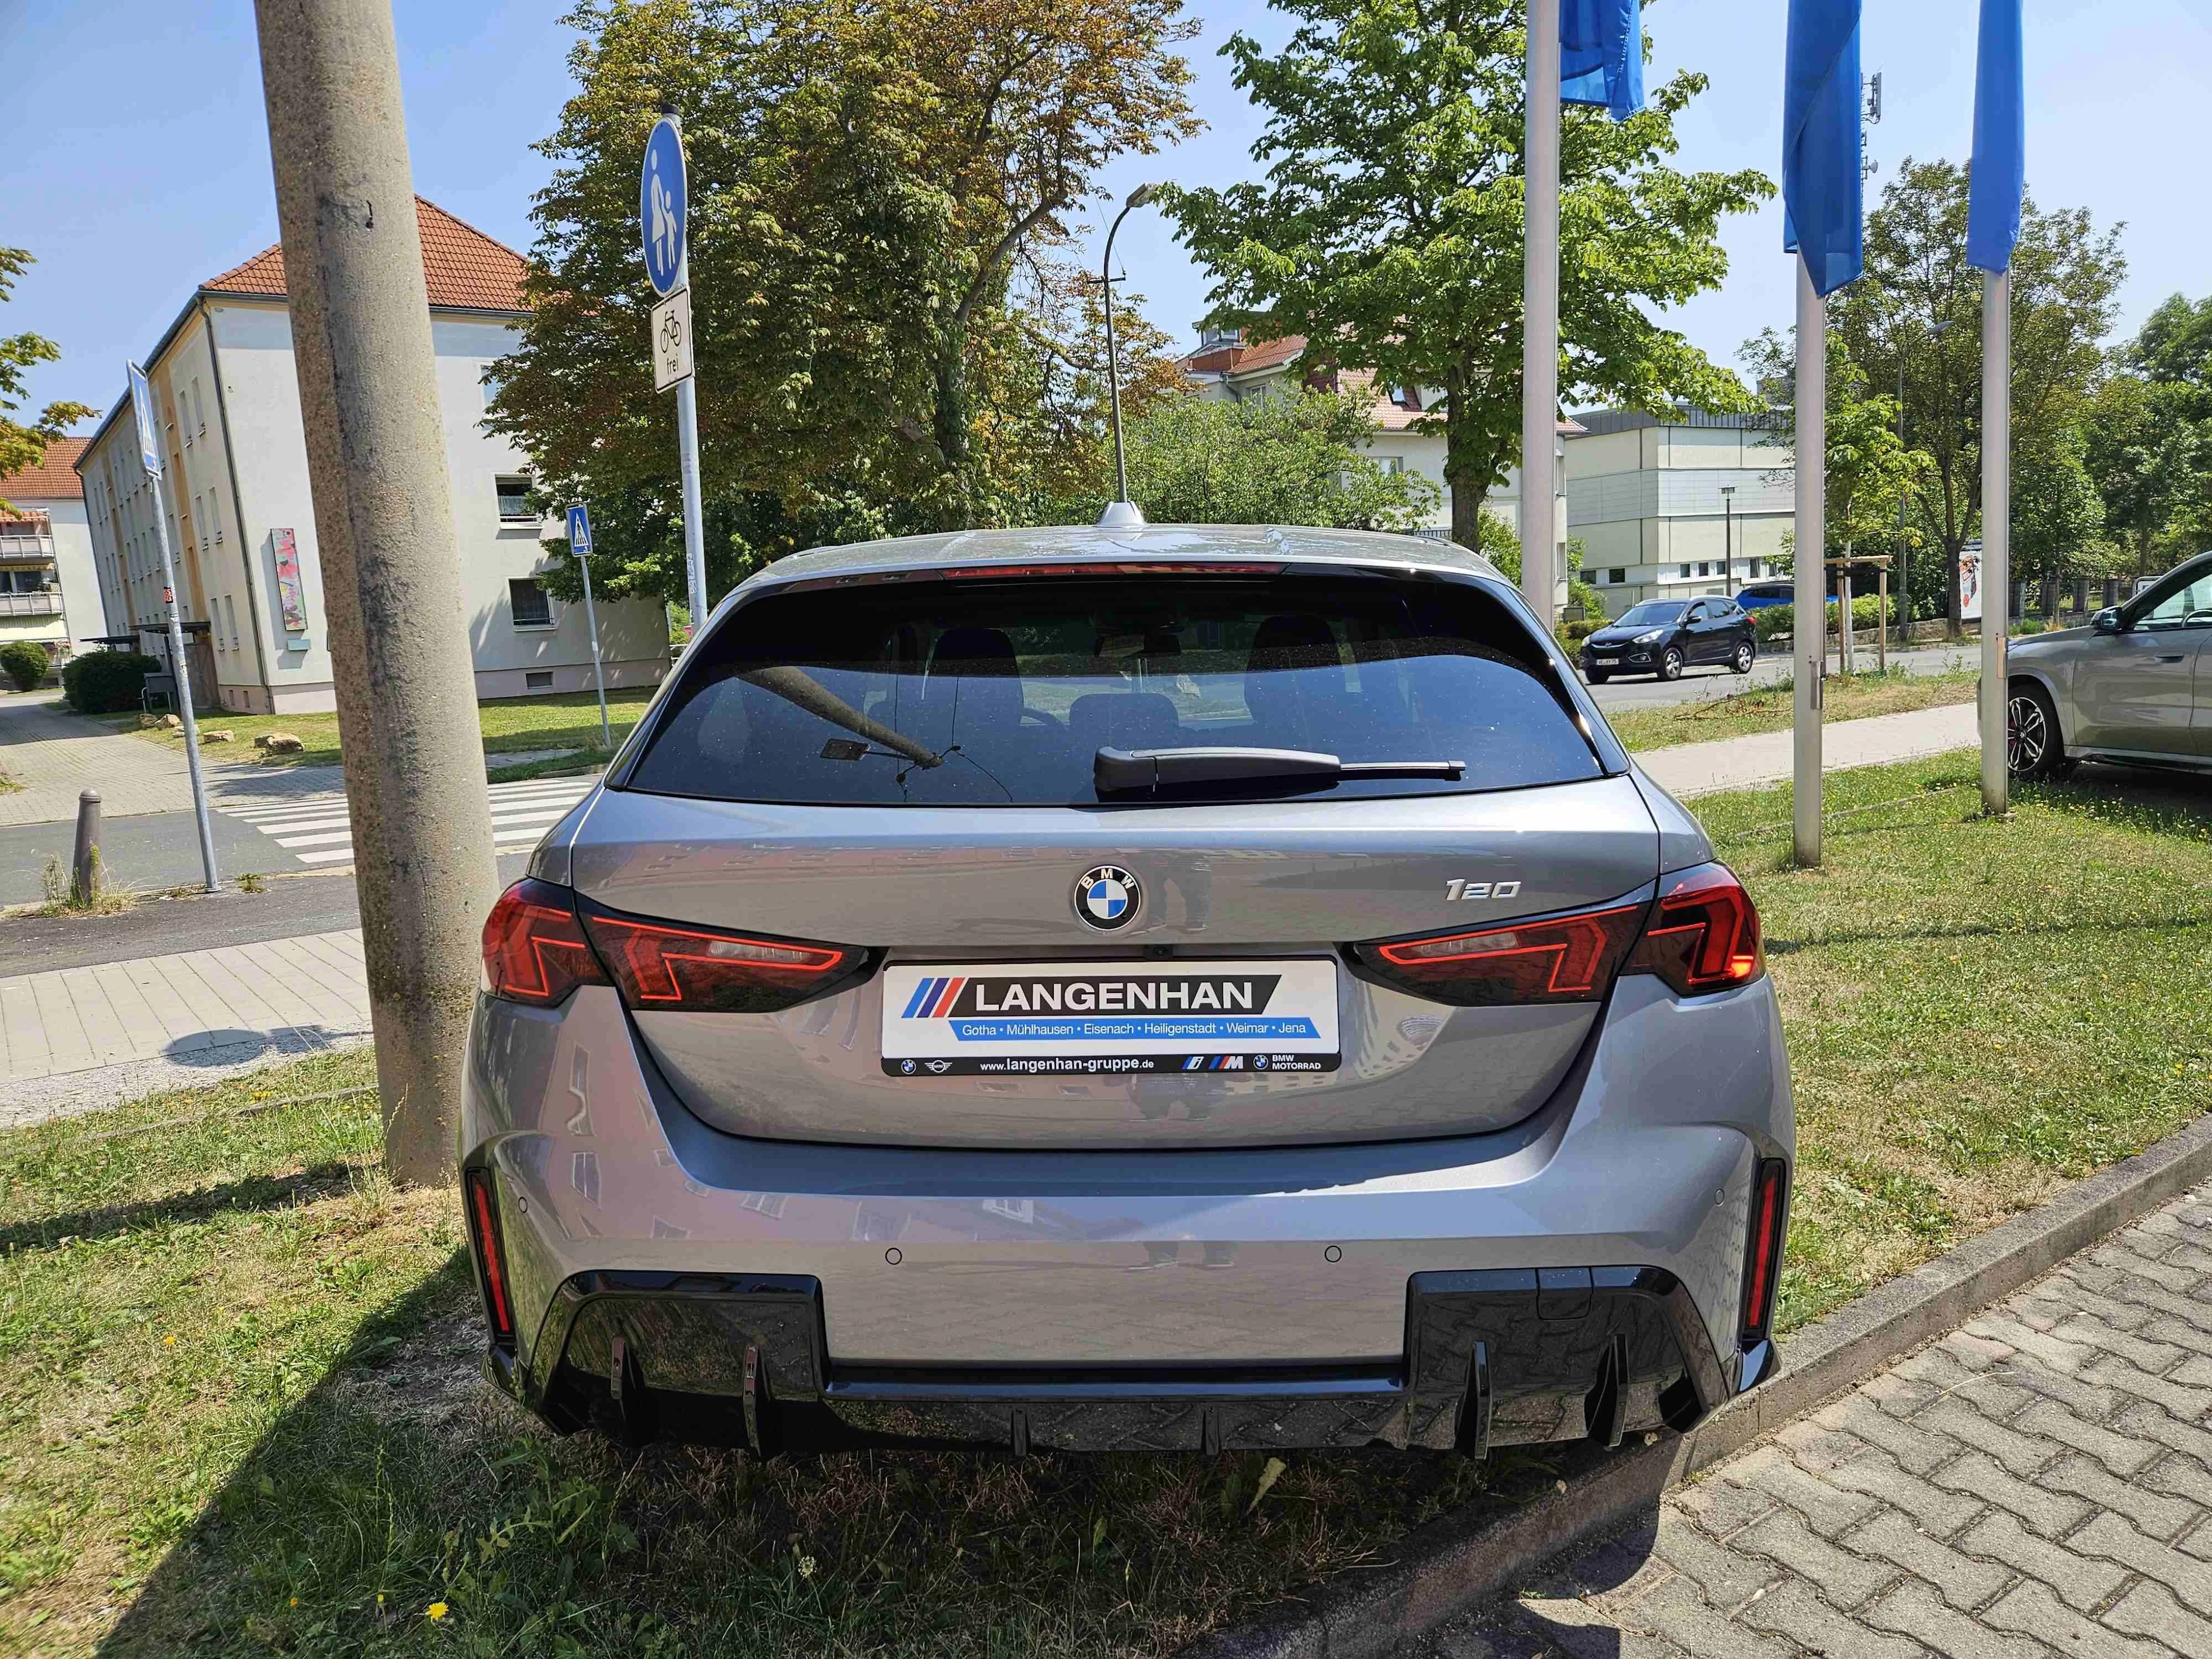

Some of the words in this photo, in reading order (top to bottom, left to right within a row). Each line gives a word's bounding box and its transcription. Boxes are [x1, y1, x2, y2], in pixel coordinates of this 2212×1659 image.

[667, 354, 679, 375] frei
[1081, 868, 1135, 889] BMW
[1446, 878, 1521, 900] 120
[976, 982, 1253, 1011] LANGENHAN
[962, 1024, 996, 1036] Gotha
[1006, 1024, 1073, 1035] Mühlhausen
[1084, 1023, 1134, 1034] Eisenach
[1145, 1022, 1216, 1036] Heiligenstadt
[1226, 1022, 1269, 1033] Weimar
[1279, 1022, 1306, 1033] Jena
[980, 1057, 1154, 1073] www.langenhan-gruppe.de
